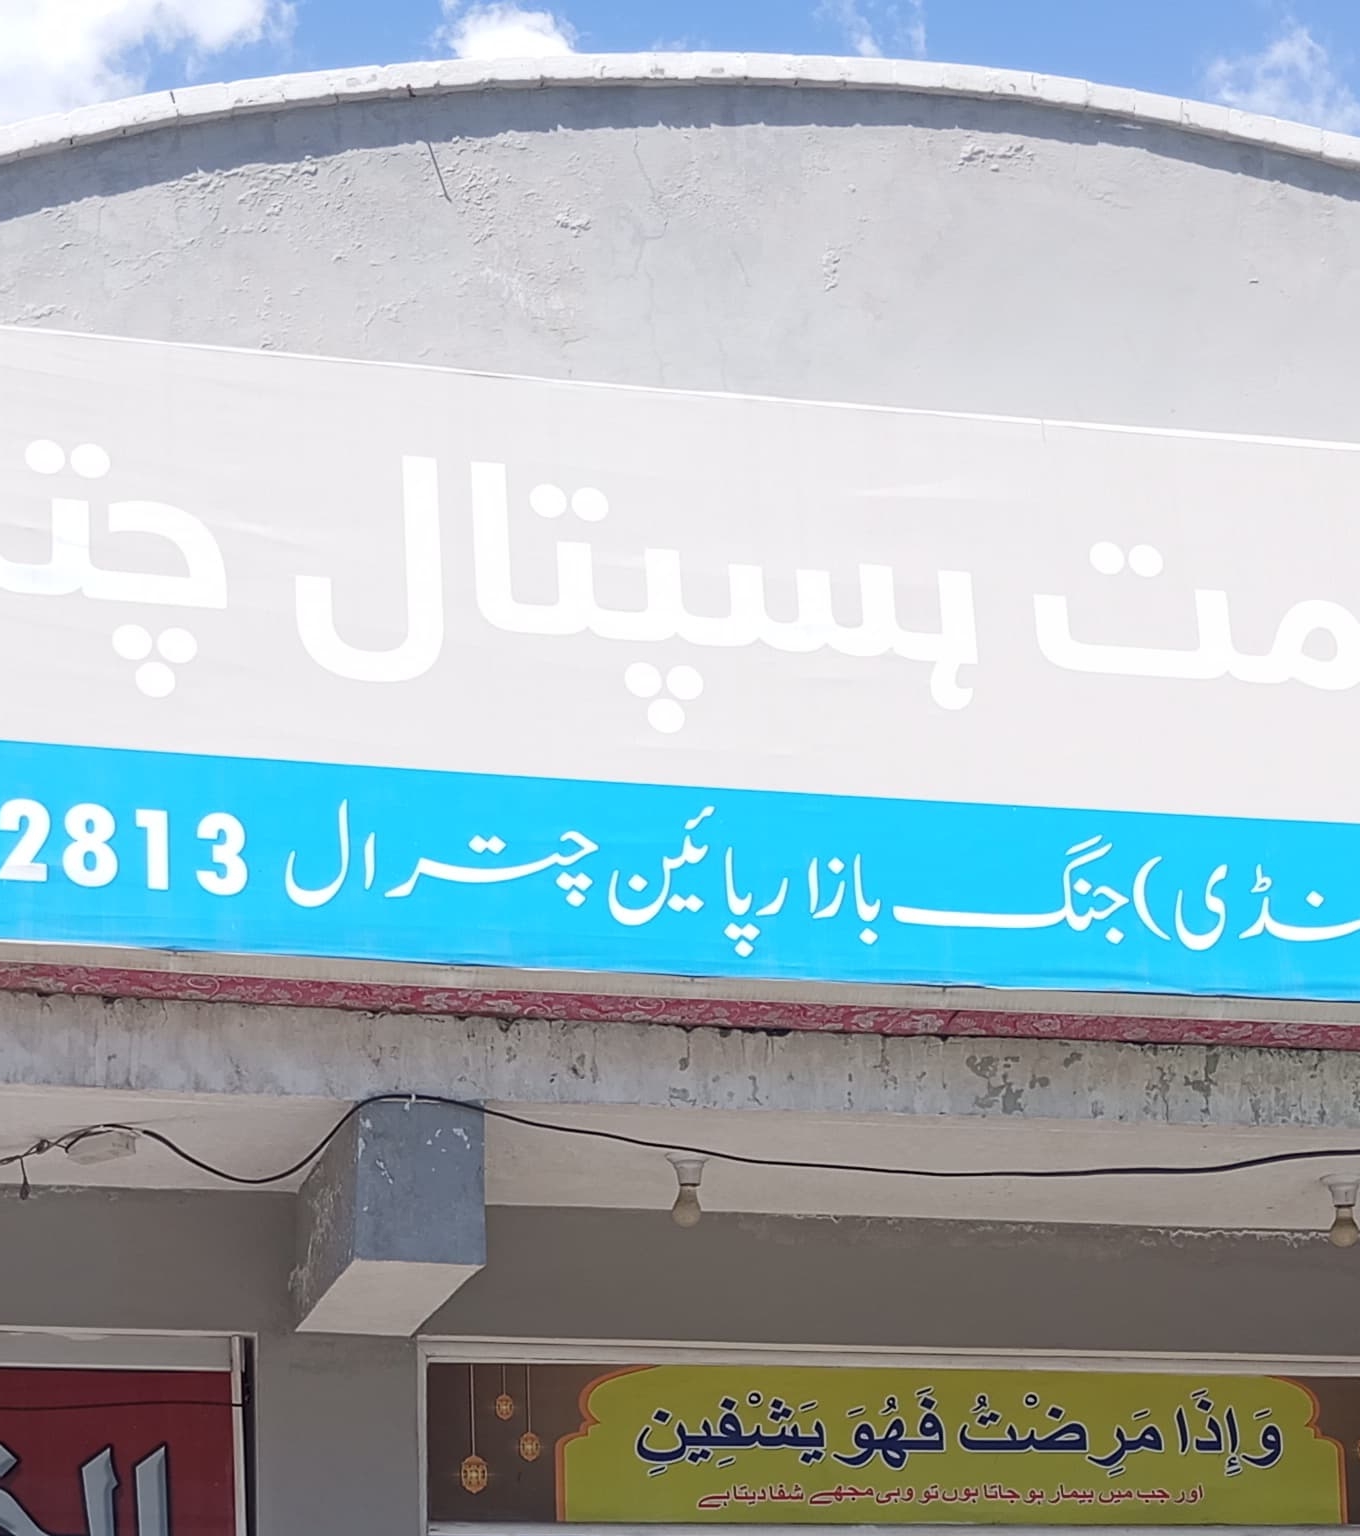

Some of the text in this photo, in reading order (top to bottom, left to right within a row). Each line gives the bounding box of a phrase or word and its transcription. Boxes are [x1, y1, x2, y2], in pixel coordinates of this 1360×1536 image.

[294, 454, 980, 735] ہسپتال
[283, 798, 599, 909] چترال
[893, 833, 1130, 945] جنگ
[809, 1485, 874, 1505] مجھے
[918, 1485, 938, 1504] تو
[941, 1487, 979, 1504] ہوں
[984, 1484, 1019, 1504] جاتا
[1049, 1484, 1093, 1504] بیمار
[1099, 1490, 1132, 1503] میں
[1137, 1487, 1169, 1504] جب
[1175, 1485, 1203, 1503] اور
